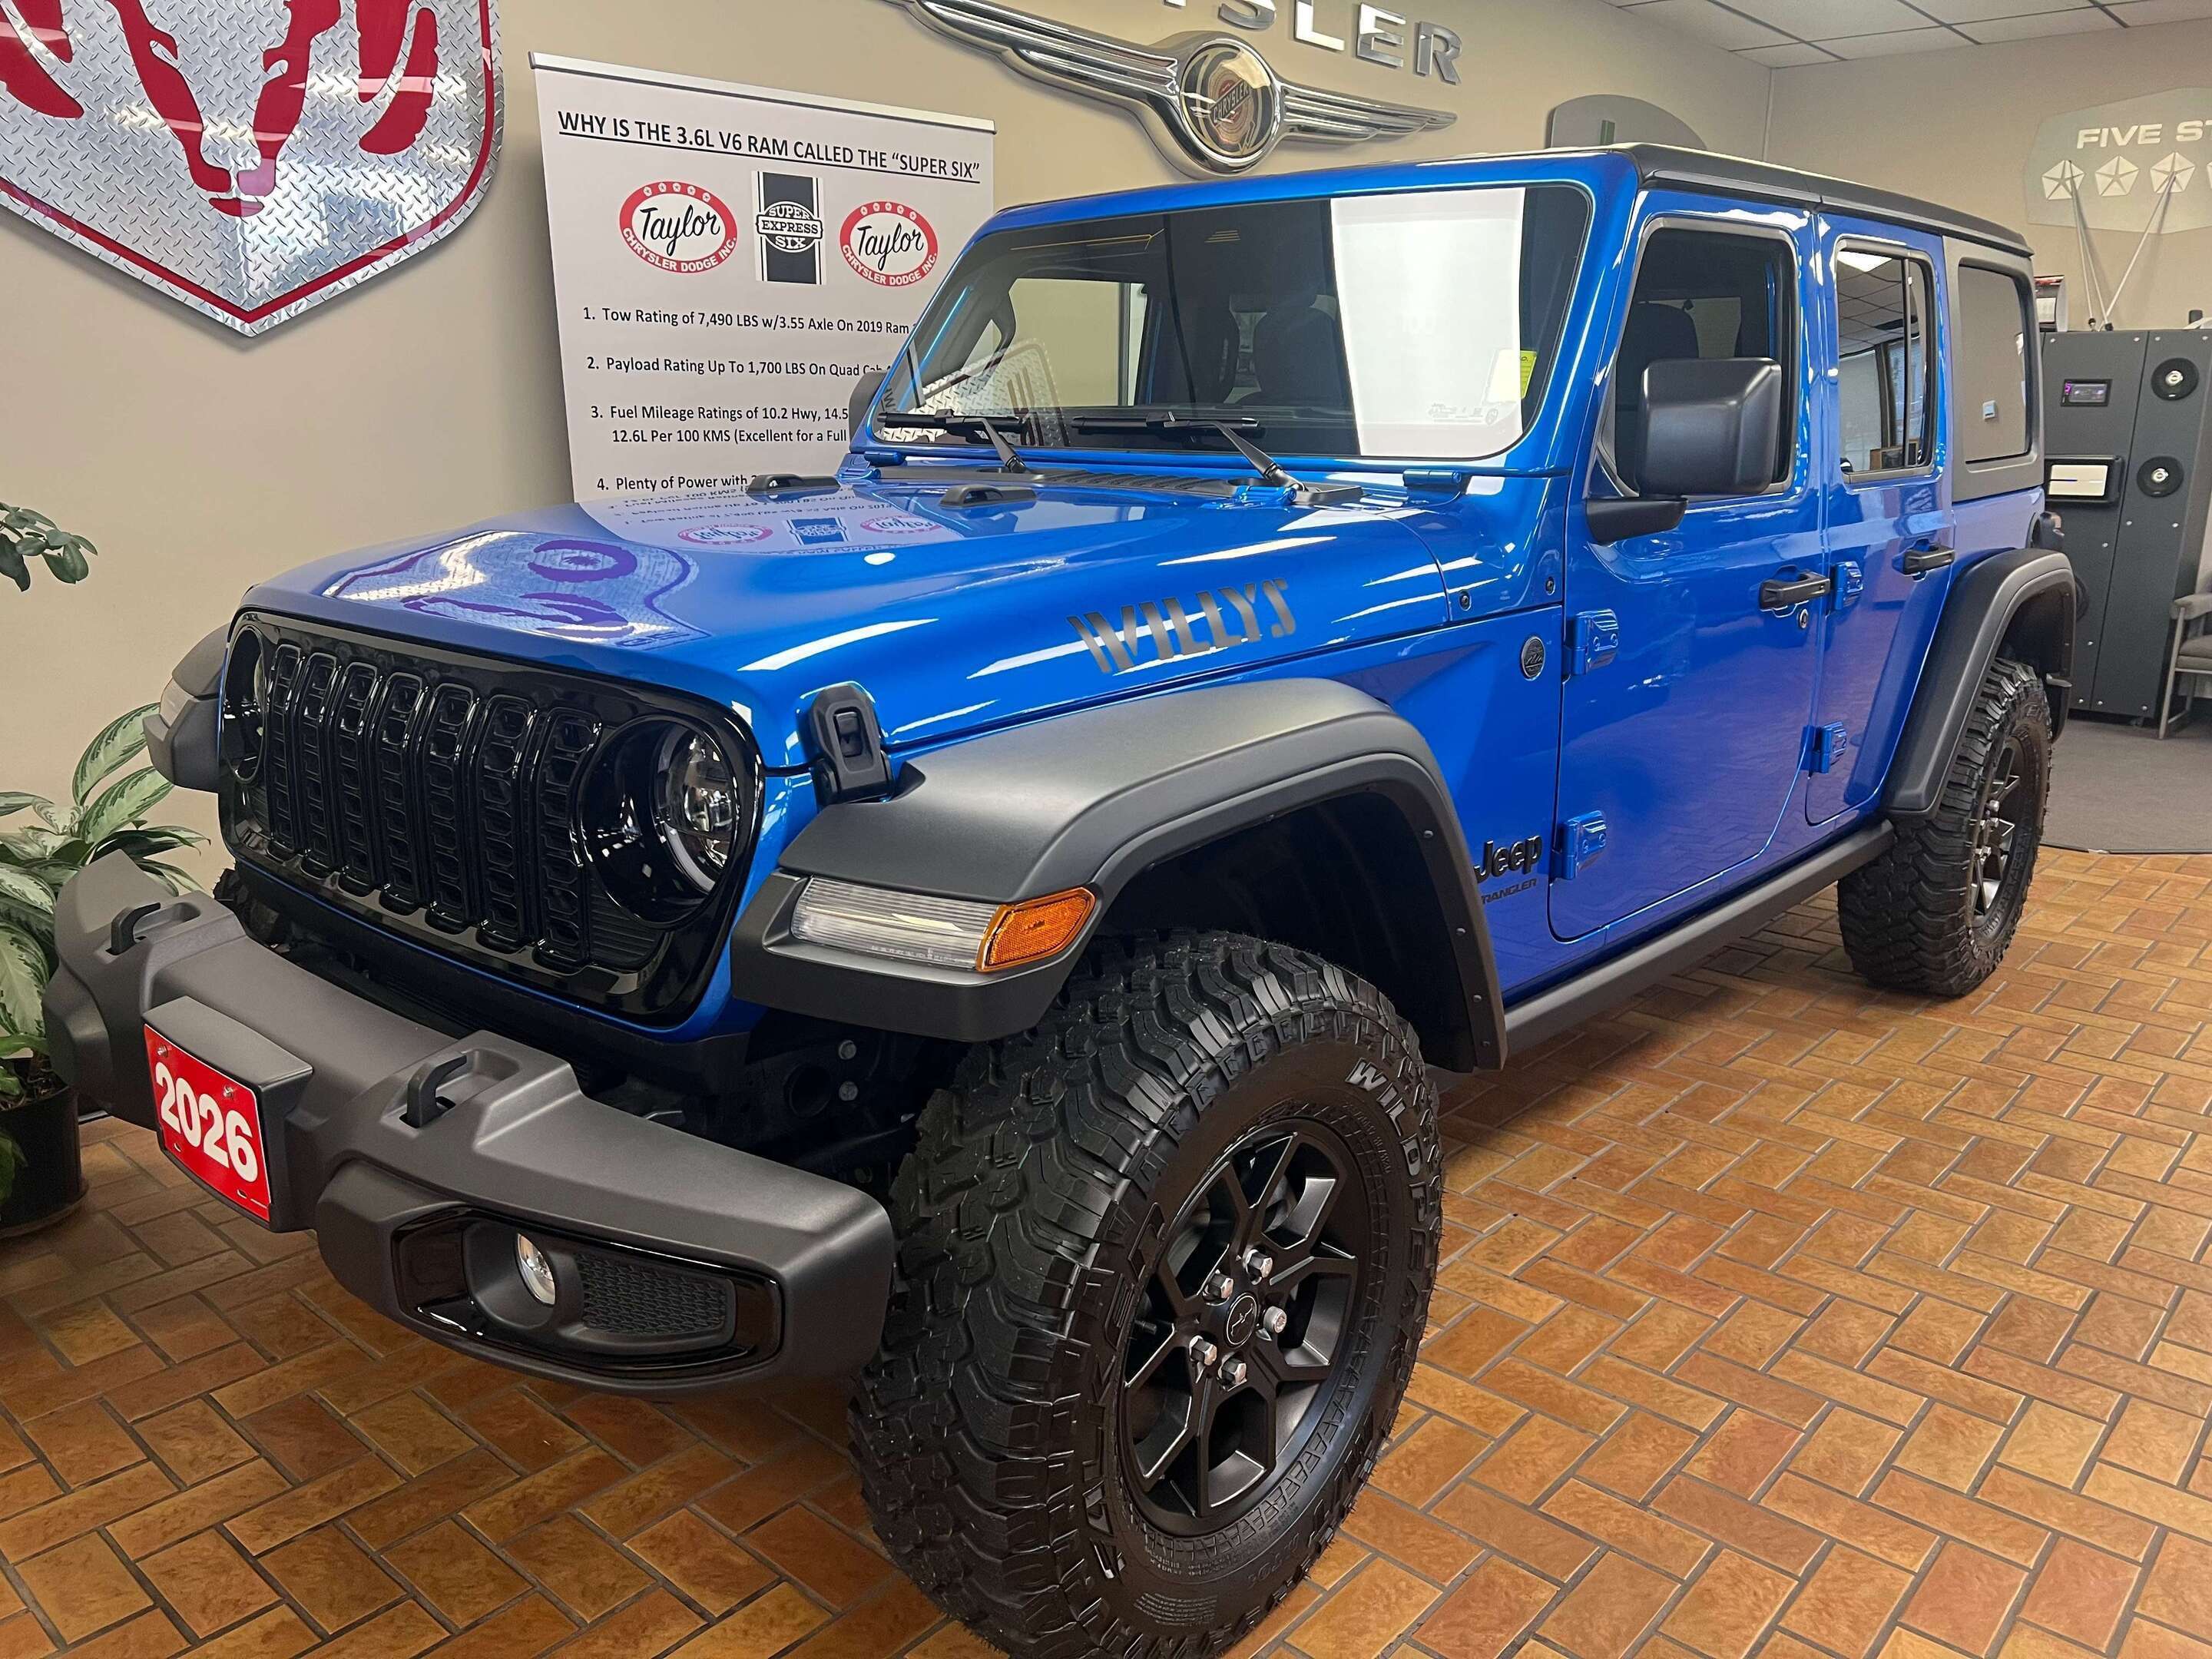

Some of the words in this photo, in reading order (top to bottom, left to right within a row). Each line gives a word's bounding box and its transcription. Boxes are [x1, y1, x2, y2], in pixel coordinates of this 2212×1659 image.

[1164, 0, 1462, 85] SLER
[558, 111, 606, 134] WHY
[613, 118, 630, 137] IS
[634, 121, 671, 142] THE
[677, 127, 714, 147] 3.6L
[719, 131, 742, 151] V6
[748, 135, 788, 156] RAM
[793, 141, 853, 163] CALLED
[858, 149, 887, 167] THE
[2076, 124, 2163, 149] FIVE
[2175, 119, 2212, 142] S
[761, 220, 819, 234] EXPRESS
[769, 205, 811, 220] SUPER
[640, 204, 720, 257] Taylor
[775, 235, 806, 249] SIX
[623, 227, 677, 271] CHRYSLER
[680, 256, 718, 272] DODGE
[718, 237, 737, 260] INC.
[857, 222, 924, 271] Taylor
[843, 244, 886, 285] CHRYSLER
[889, 270, 922, 286] DODGE
[922, 253, 937, 274] INC.
[583, 307, 595, 320] 1.
[602, 308, 631, 322] Tow
[636, 310, 678, 326] Rating
[682, 311, 694, 324] of
[697, 313, 733, 327] 7,490
[737, 314, 758, 327] LBS
[762, 315, 805, 330] w/3.55
[808, 318, 833, 330] Axle
[837, 319, 853, 331] On
[856, 320, 882, 333] 2019
[886, 322, 909, 334] Ram
[587, 356, 599, 369] 2.
[607, 357, 660, 373] Payload
[664, 359, 704, 375] Rating
[708, 360, 725, 376] Up
[729, 361, 744, 373] To
[748, 361, 782, 376] 1,700
[786, 363, 806, 374] LBS
[810, 363, 826, 375] On
[830, 363, 859, 377] Quad
[591, 406, 603, 419] 3.
[610, 405, 637, 419] Fuel
[642, 406, 694, 422] Mileage
[697, 406, 743, 422] Ratings
[746, 406, 759, 419] of
[762, 407, 788, 419] 10.2
[792, 408, 821, 422] Hwy,
[825, 408, 849, 419] 14.5
[612, 429, 647, 442] 12.6L
[651, 430, 673, 442] Per
[677, 429, 700, 442] 100
[704, 429, 730, 442] KMS
[734, 429, 793, 445] (Excellent
[796, 429, 813, 442] for
[816, 432, 823, 442] a
[827, 429, 846, 442] Full
[597, 478, 609, 490] 4.
[616, 477, 657, 492] Plenty
[661, 476, 674, 488] of
[678, 476, 717, 488] Power
[720, 475, 747, 486] with
[1067, 578, 1296, 673] WILLYS
[1474, 835, 1542, 883] Jeep
[1481, 878, 1538, 904] RANGLER
[155, 1061, 258, 1183] 2026
